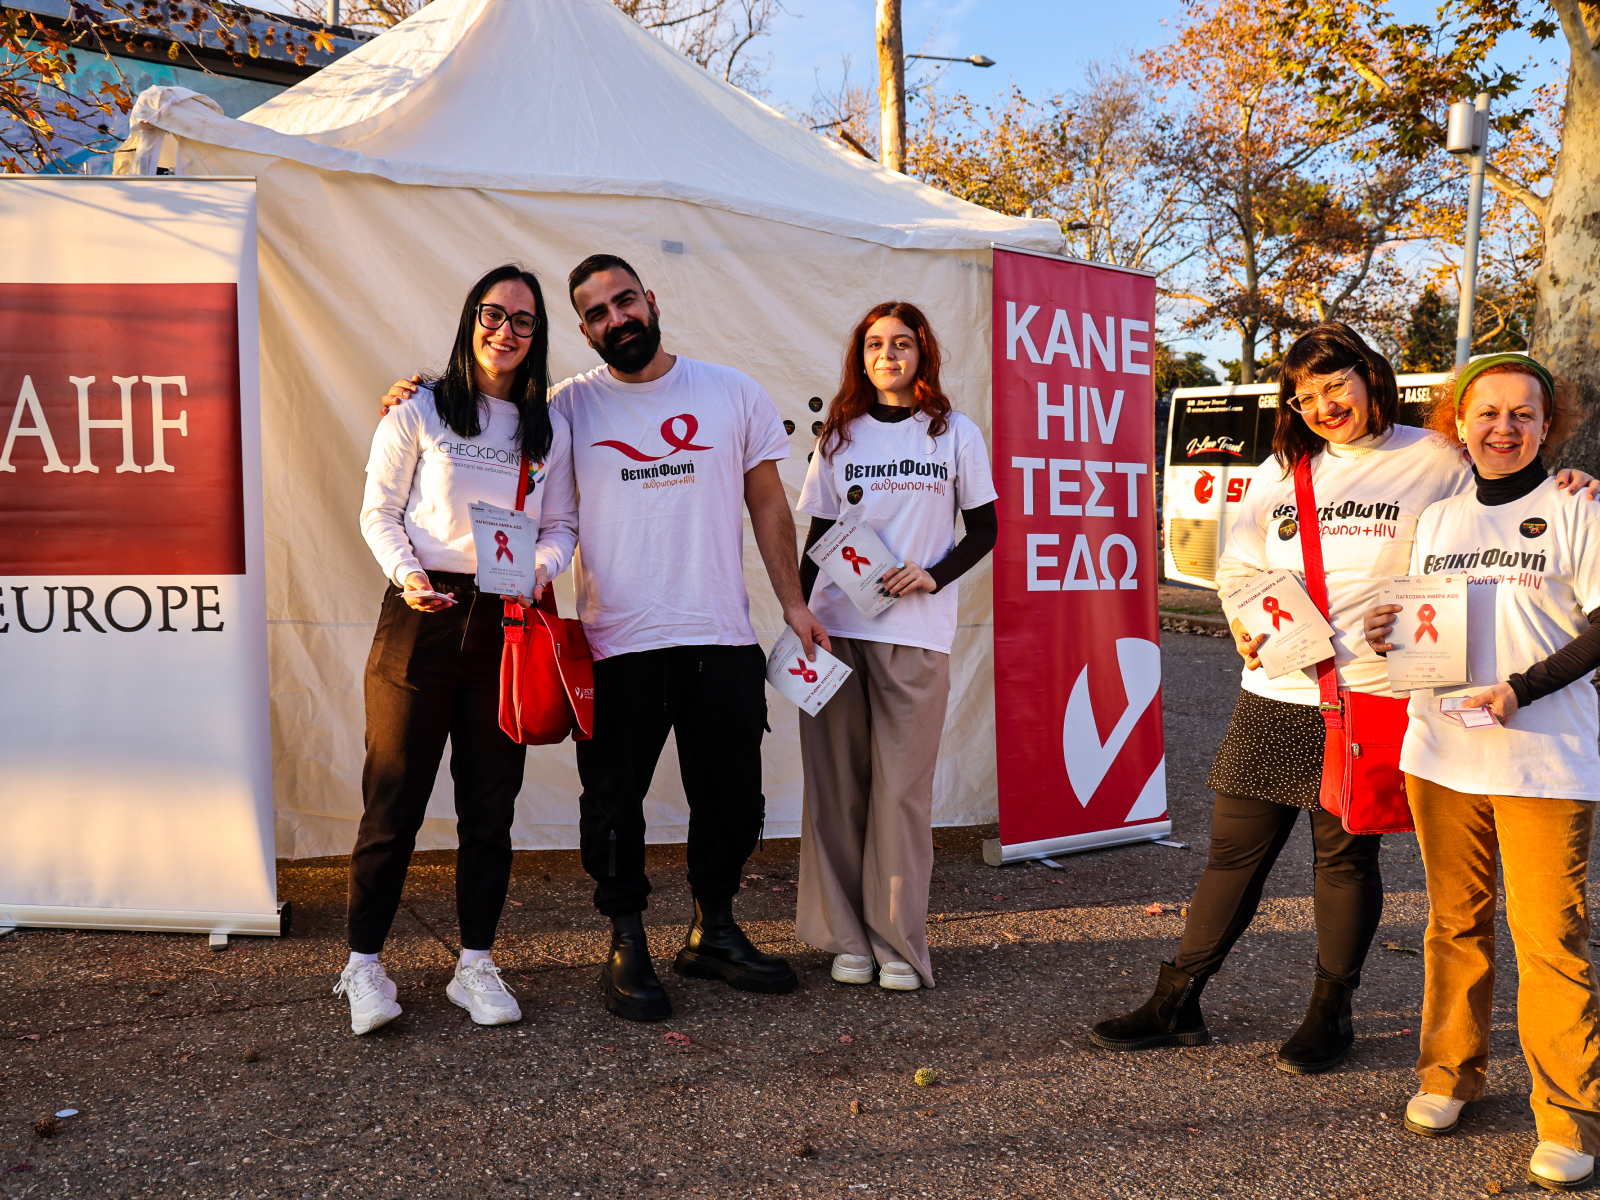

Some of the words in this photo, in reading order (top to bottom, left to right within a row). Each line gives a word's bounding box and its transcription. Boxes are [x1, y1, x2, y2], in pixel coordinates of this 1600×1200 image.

[1006, 300, 1150, 376] ΚΑΝΕ
[0, 374, 188, 474] AHF
[1037, 381, 1125, 445] HIV
[1258, 394, 1280, 409] GENE
[1404, 387, 1432, 403] BASEL
[1011, 455, 1148, 518] ΤΕΣΤ
[1026, 532, 1138, 592] ΕΔΩ
